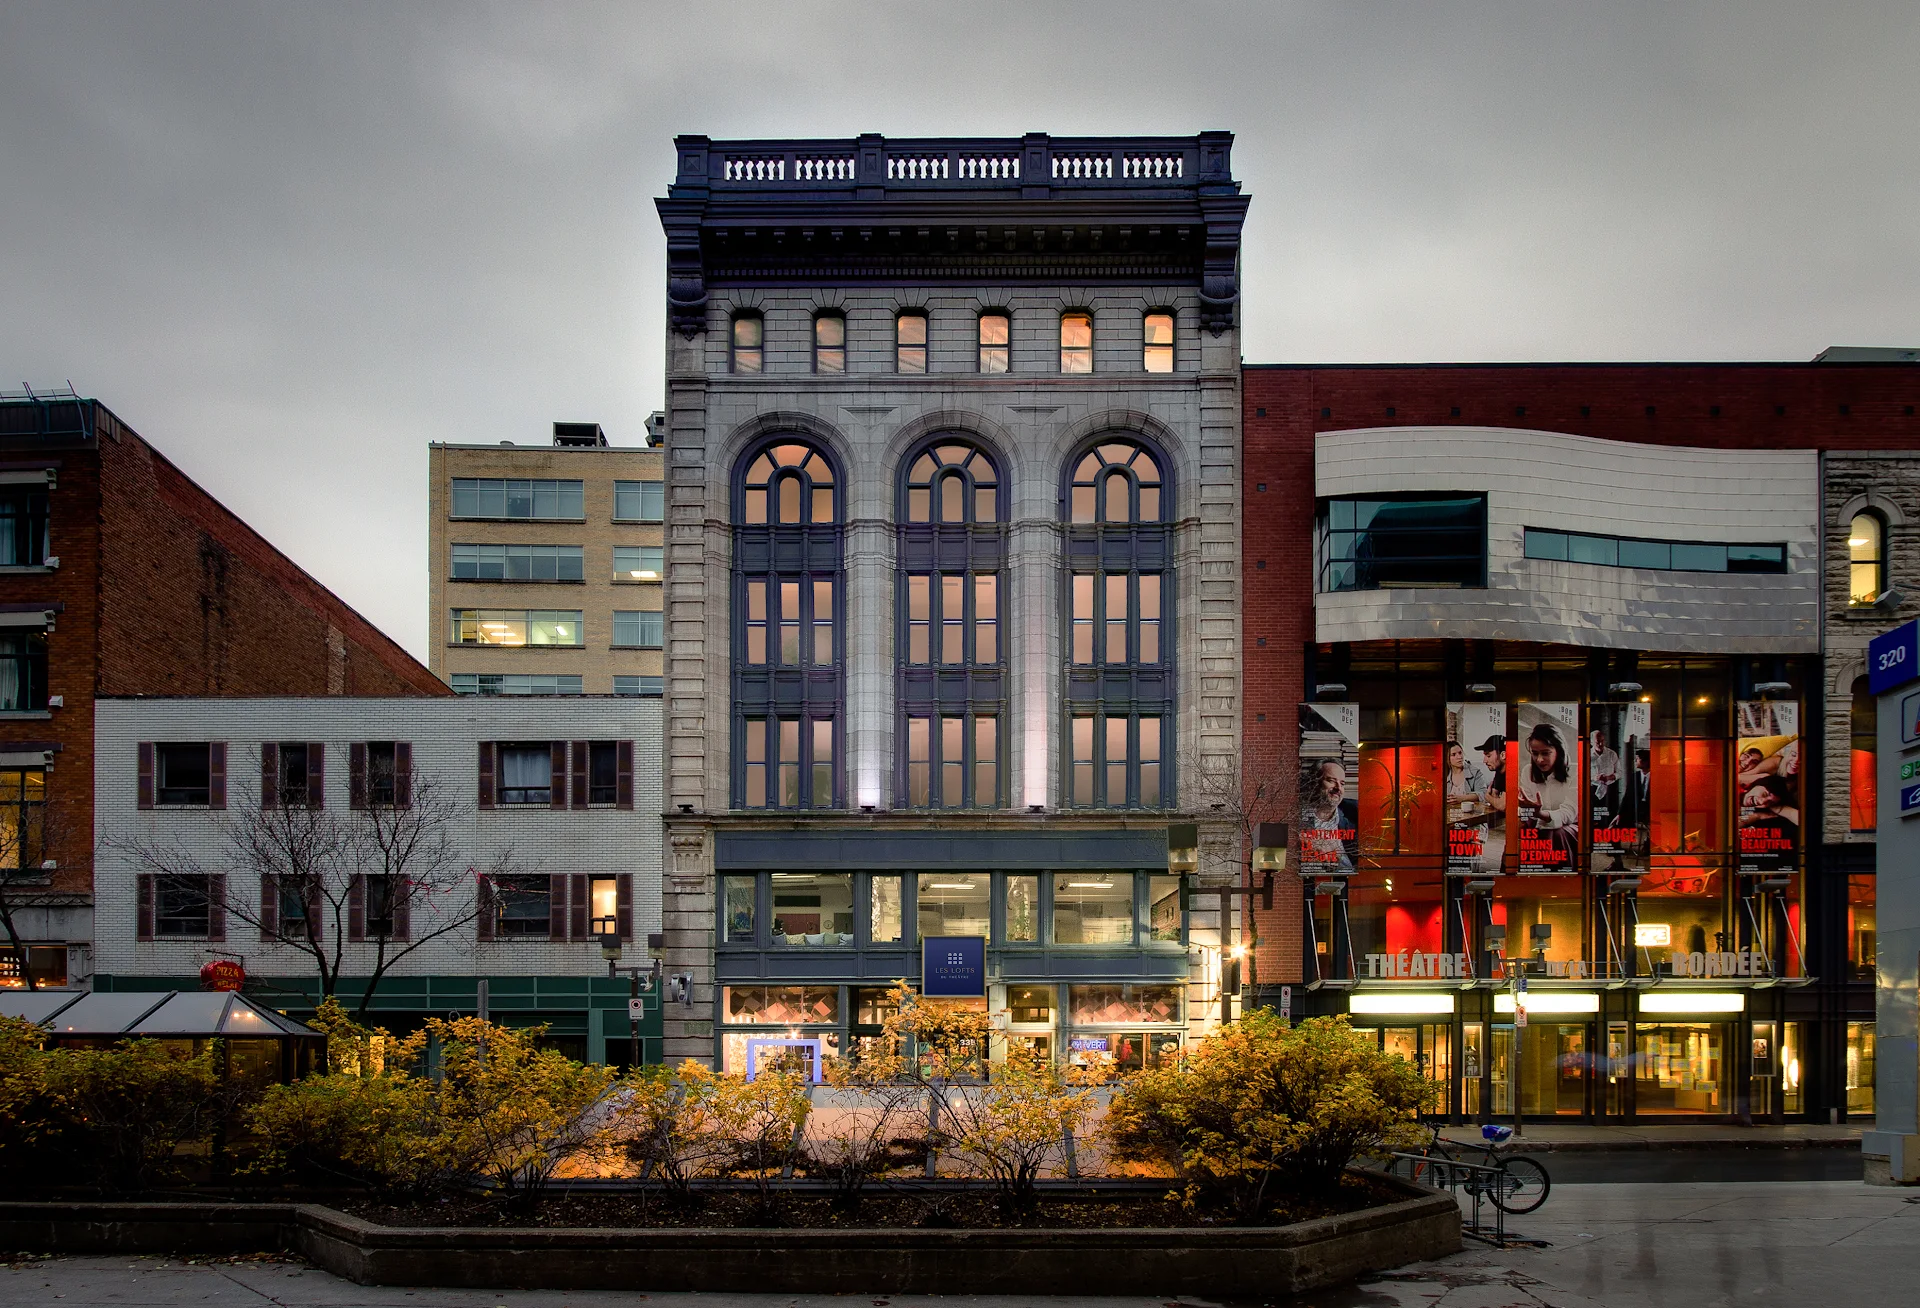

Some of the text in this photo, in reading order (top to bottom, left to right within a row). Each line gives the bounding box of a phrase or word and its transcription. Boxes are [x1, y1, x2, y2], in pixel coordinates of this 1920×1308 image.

[1879, 646, 1906, 670] 320
[1449, 829, 1480, 842] HOPE
[1521, 829, 1538, 839] LES
[1594, 828, 1637, 842] ROUGE
[1741, 828, 1781, 838] MADE IN
[1449, 843, 1484, 855] TOWN
[1521, 840, 1552, 850] MAINS
[1741, 839, 1793, 849] BEAUTIFUL
[1521, 850, 1567, 861] D'EDWIGE
[1365, 948, 1467, 977] THÉÂTRE
[1569, 960, 1587, 976] LA
[1672, 946, 1762, 976] BORDÉE
[216, 966, 239, 977] PIZZA
